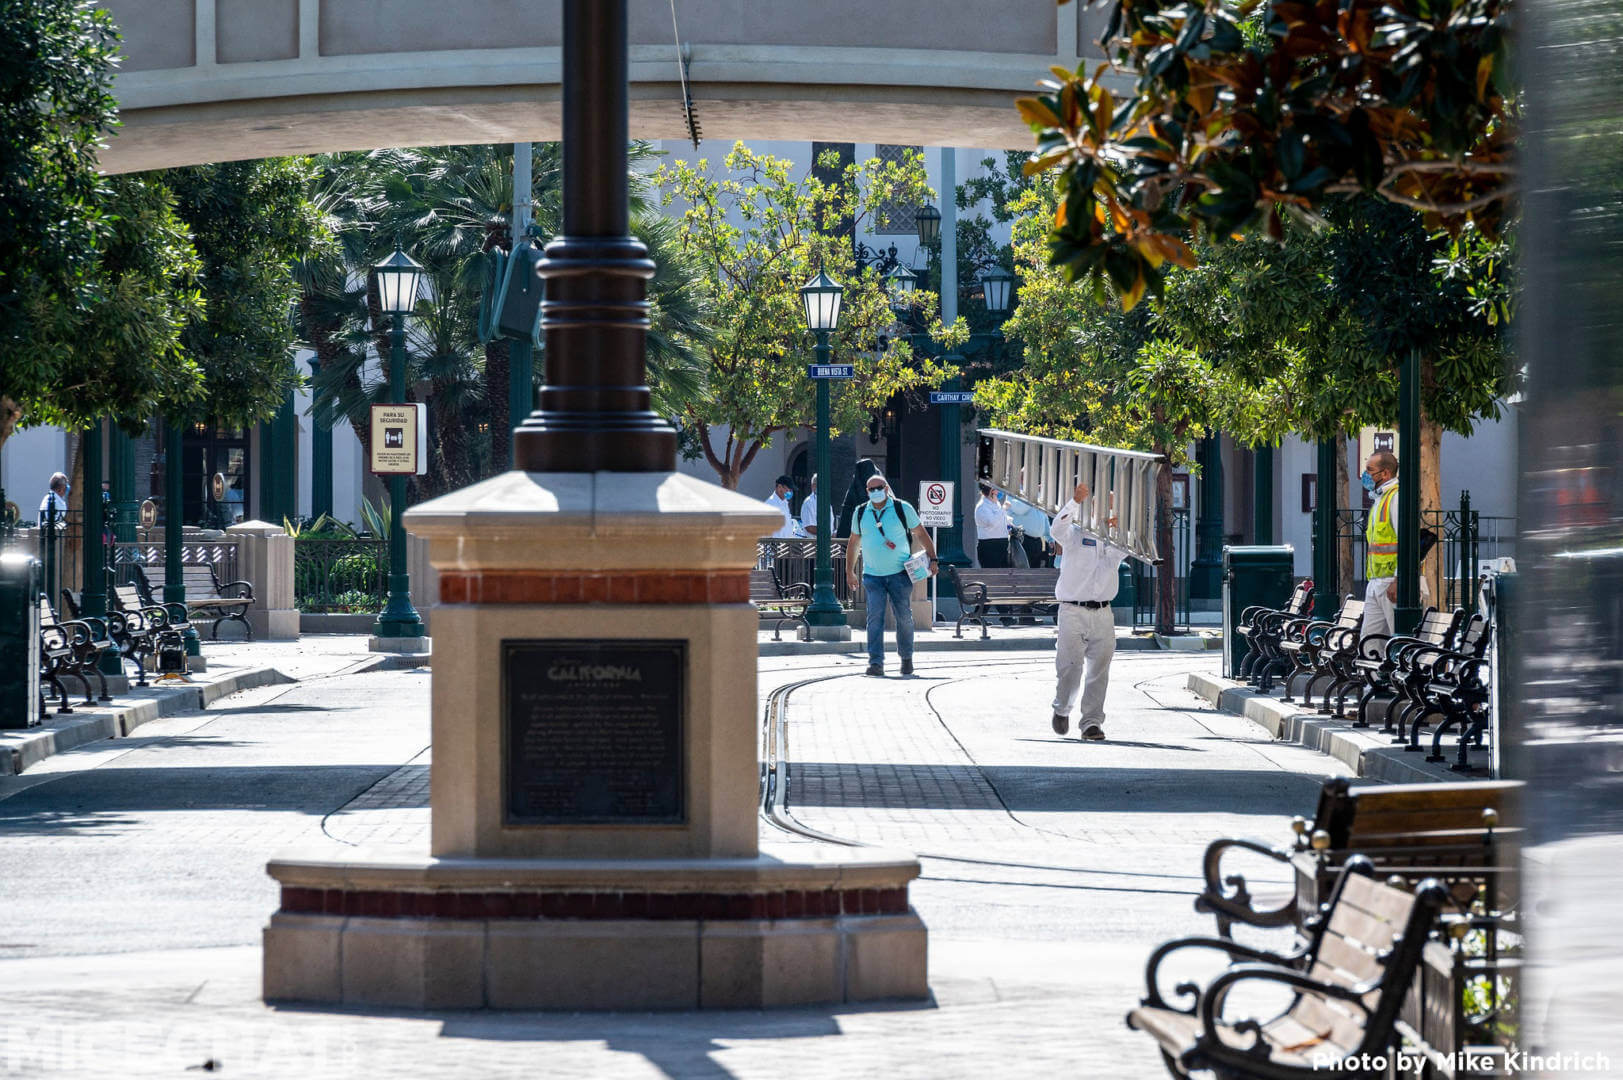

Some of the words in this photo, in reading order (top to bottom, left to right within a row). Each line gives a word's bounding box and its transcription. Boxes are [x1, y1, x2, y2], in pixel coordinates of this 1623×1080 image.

[817, 367, 830, 376] BUENA
[831, 367, 842, 376] VISTA
[547, 665, 641, 681] CALIFORNIA
